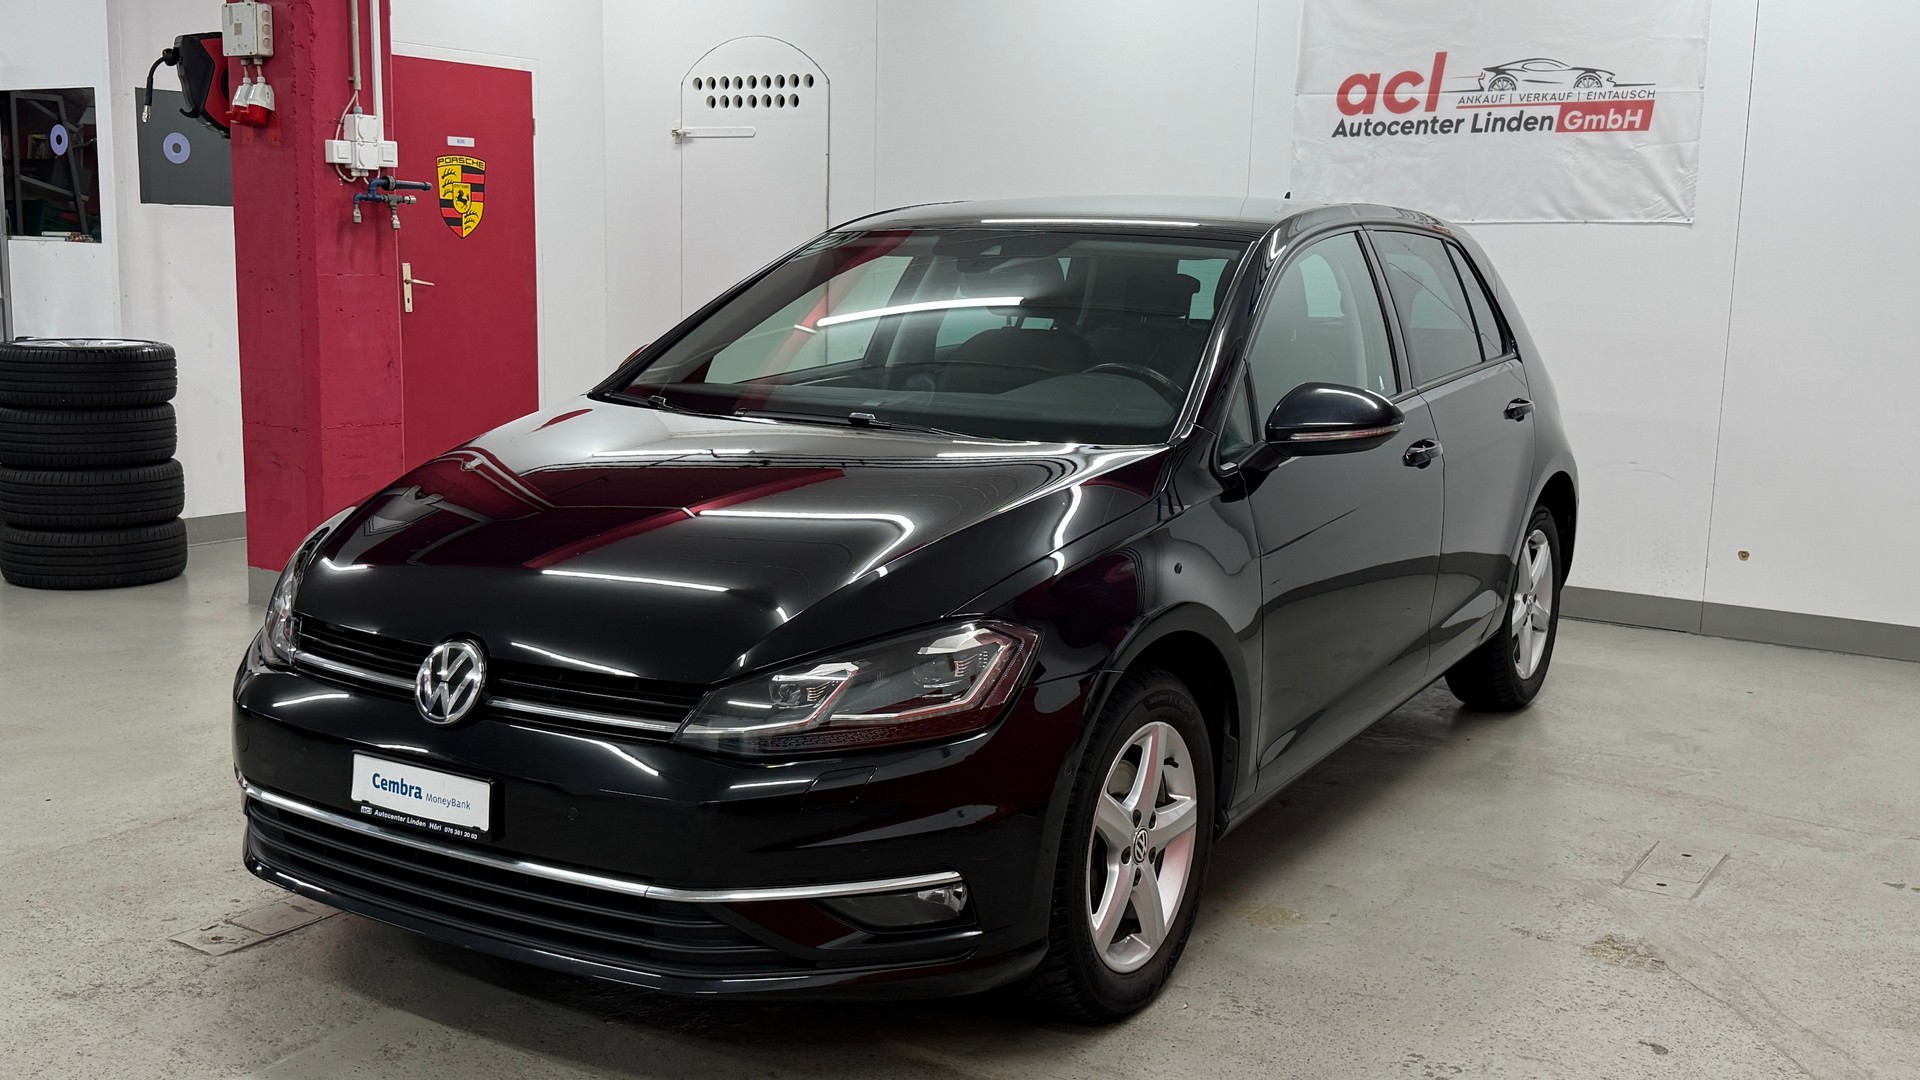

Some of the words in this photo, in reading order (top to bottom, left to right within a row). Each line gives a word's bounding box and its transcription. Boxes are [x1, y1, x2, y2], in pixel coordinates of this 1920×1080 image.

[1336, 51, 1448, 115] acl
[1457, 93, 1506, 105] ANKAUF
[1518, 91, 1574, 103] VERKAUF
[1586, 89, 1657, 101] EINTAUSCH
[1331, 115, 1465, 138] Autocenter
[1471, 110, 1555, 134] Linden
[1563, 108, 1644, 131] GmbH
[438, 157, 484, 169] PORSCHE
[372, 772, 423, 800] Cembra
[425, 793, 472, 810] MoneyBank
[374, 810, 406, 822] Autocenter
[406, 817, 426, 827] Linden
